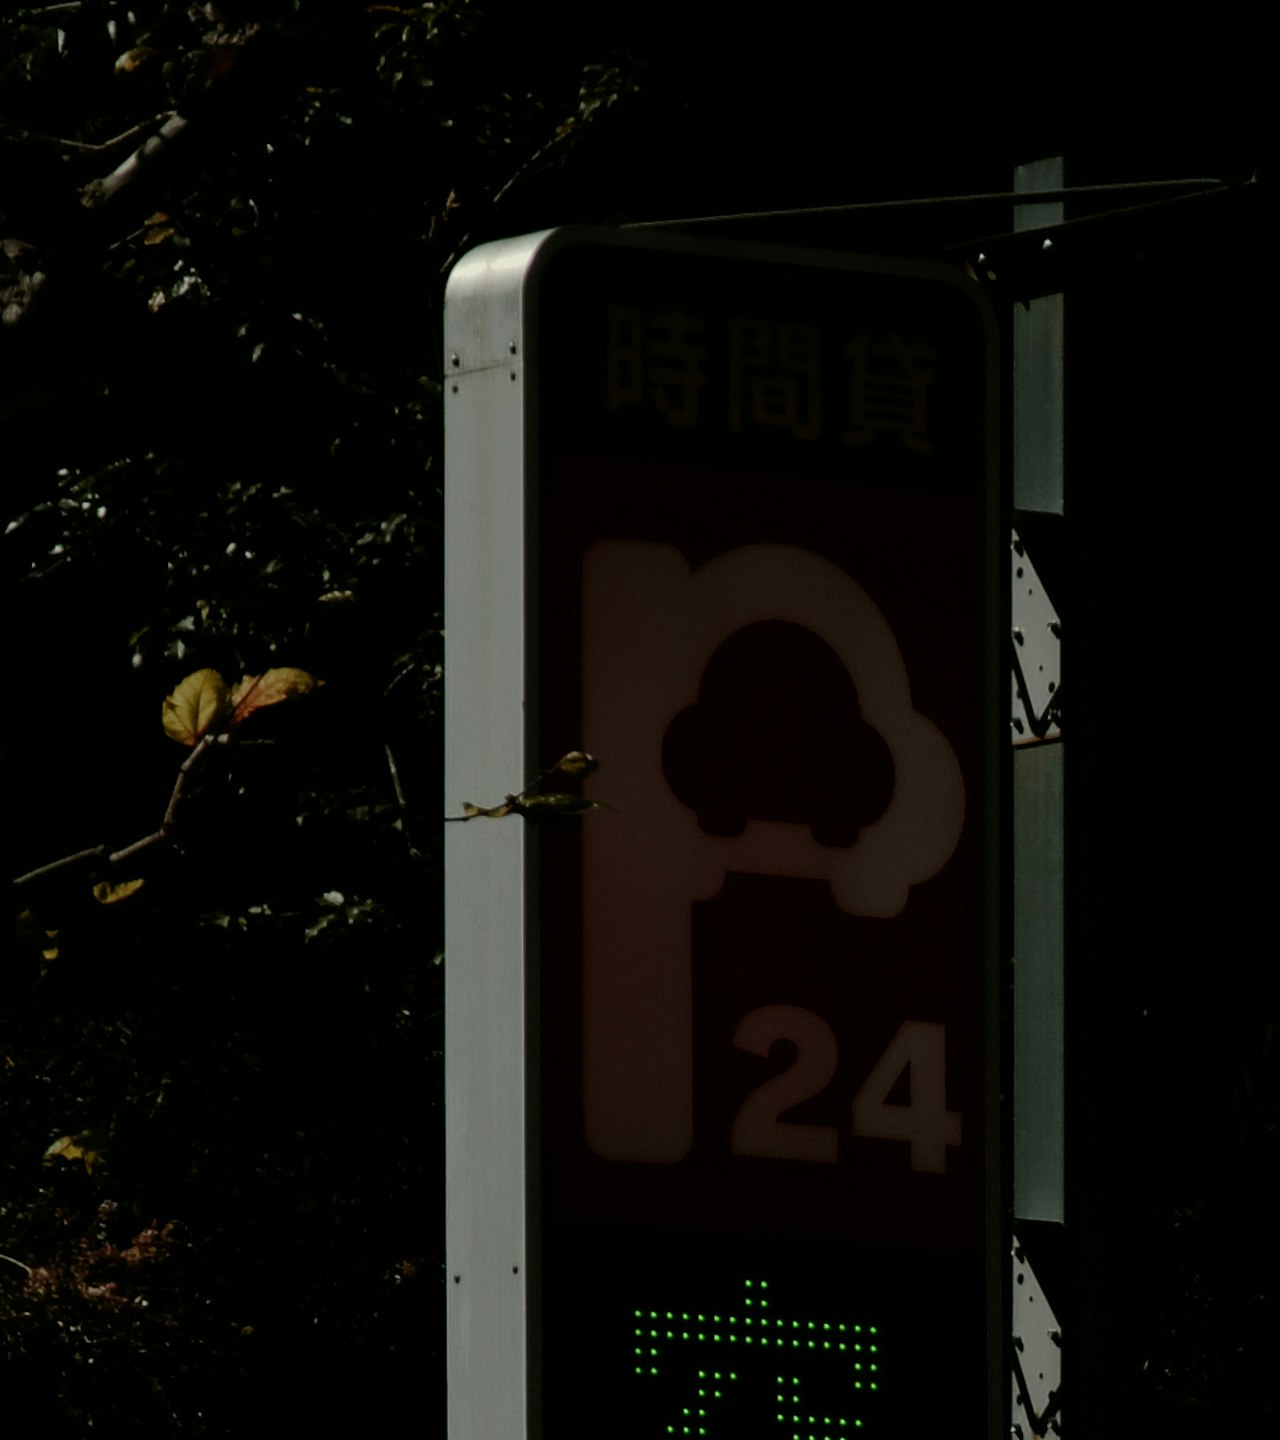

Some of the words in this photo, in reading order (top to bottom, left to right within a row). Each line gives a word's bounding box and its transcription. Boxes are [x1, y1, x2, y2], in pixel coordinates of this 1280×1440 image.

[606, 302, 938, 454] 時間貸
[730, 1004, 963, 1174] 24
